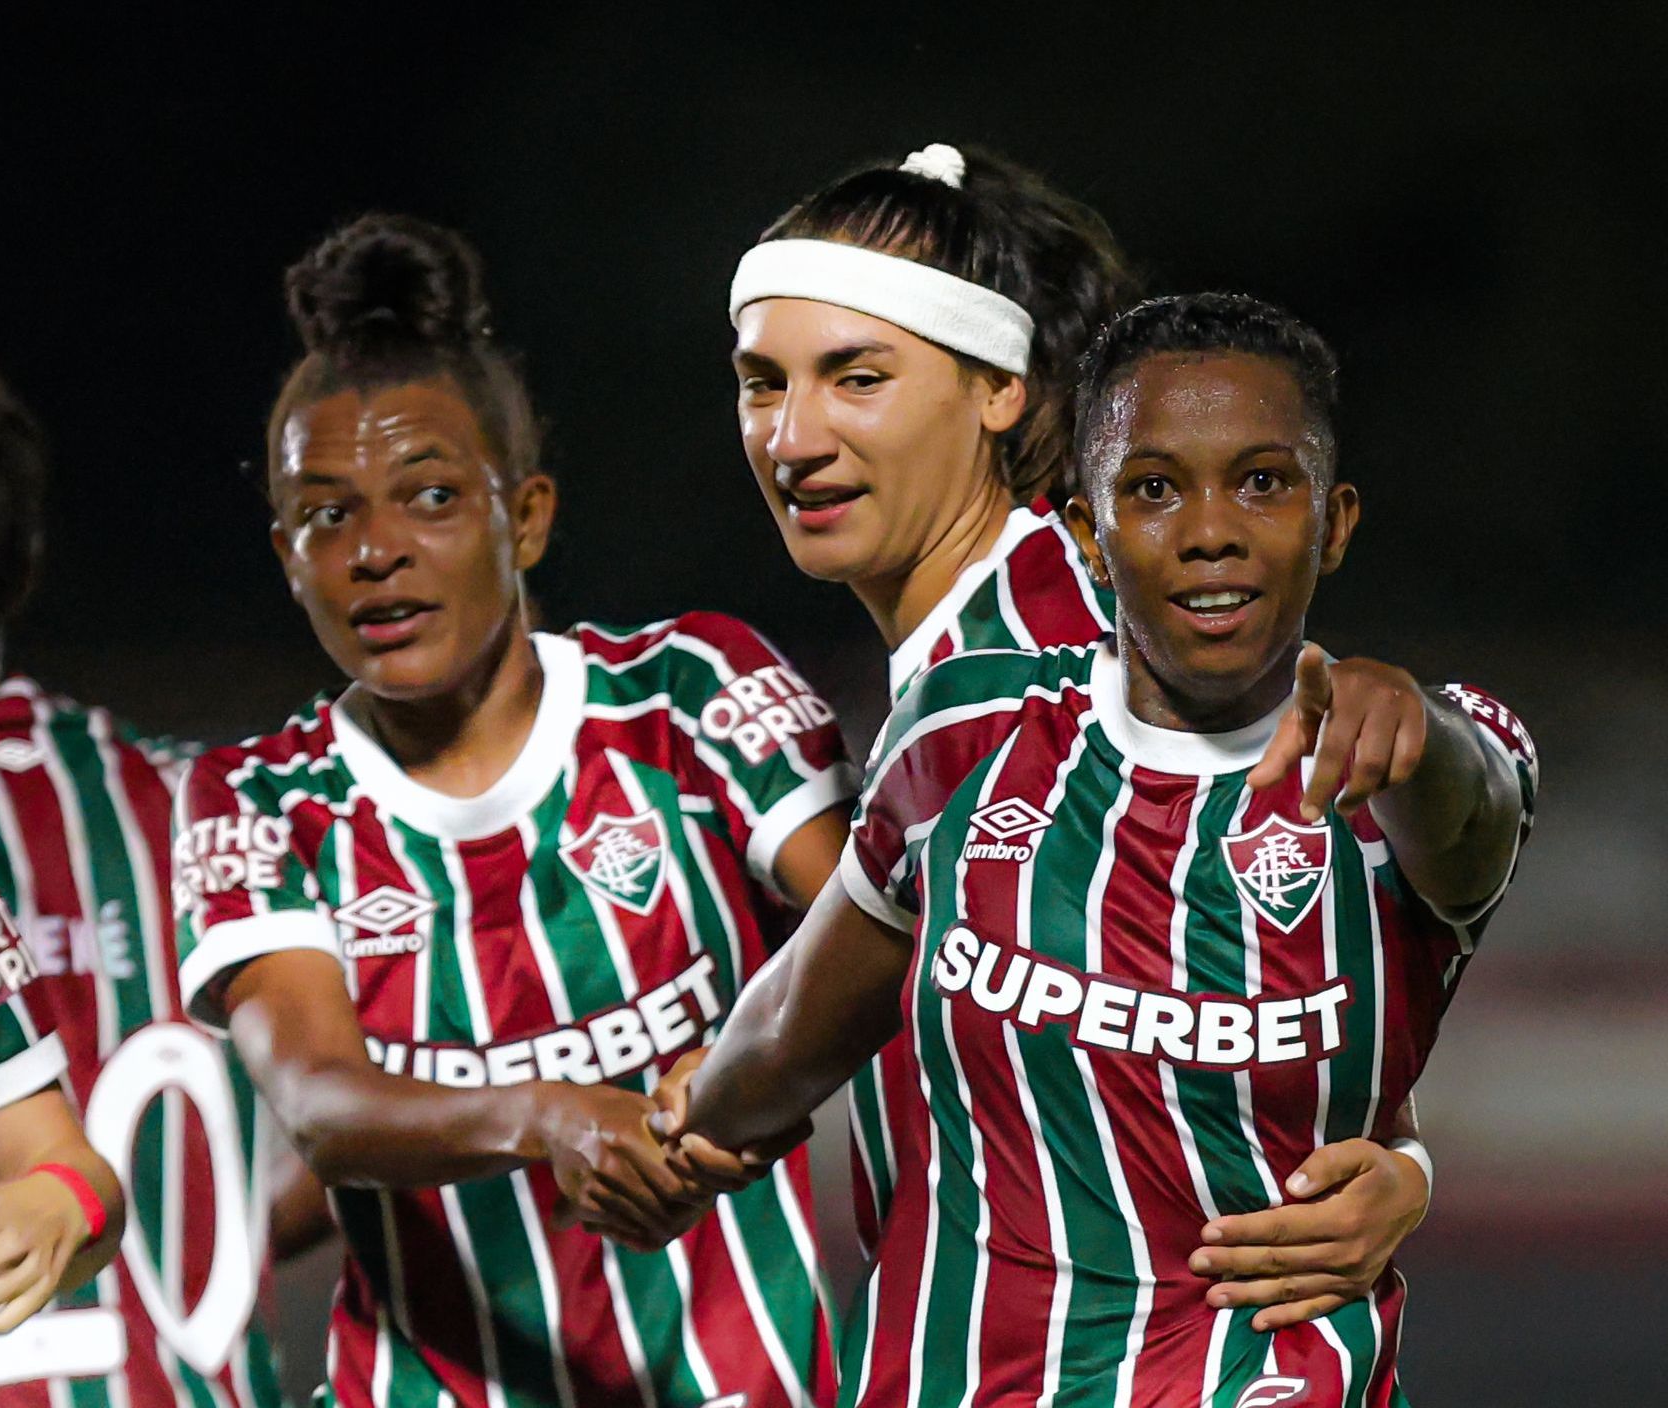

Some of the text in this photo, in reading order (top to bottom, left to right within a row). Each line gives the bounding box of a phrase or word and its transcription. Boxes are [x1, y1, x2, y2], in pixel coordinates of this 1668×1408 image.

[965, 840, 1031, 862] umbro
[343, 932, 423, 960] umbro
[364, 954, 721, 1089] UPERBET
[936, 926, 1348, 1065] SUPERBET
